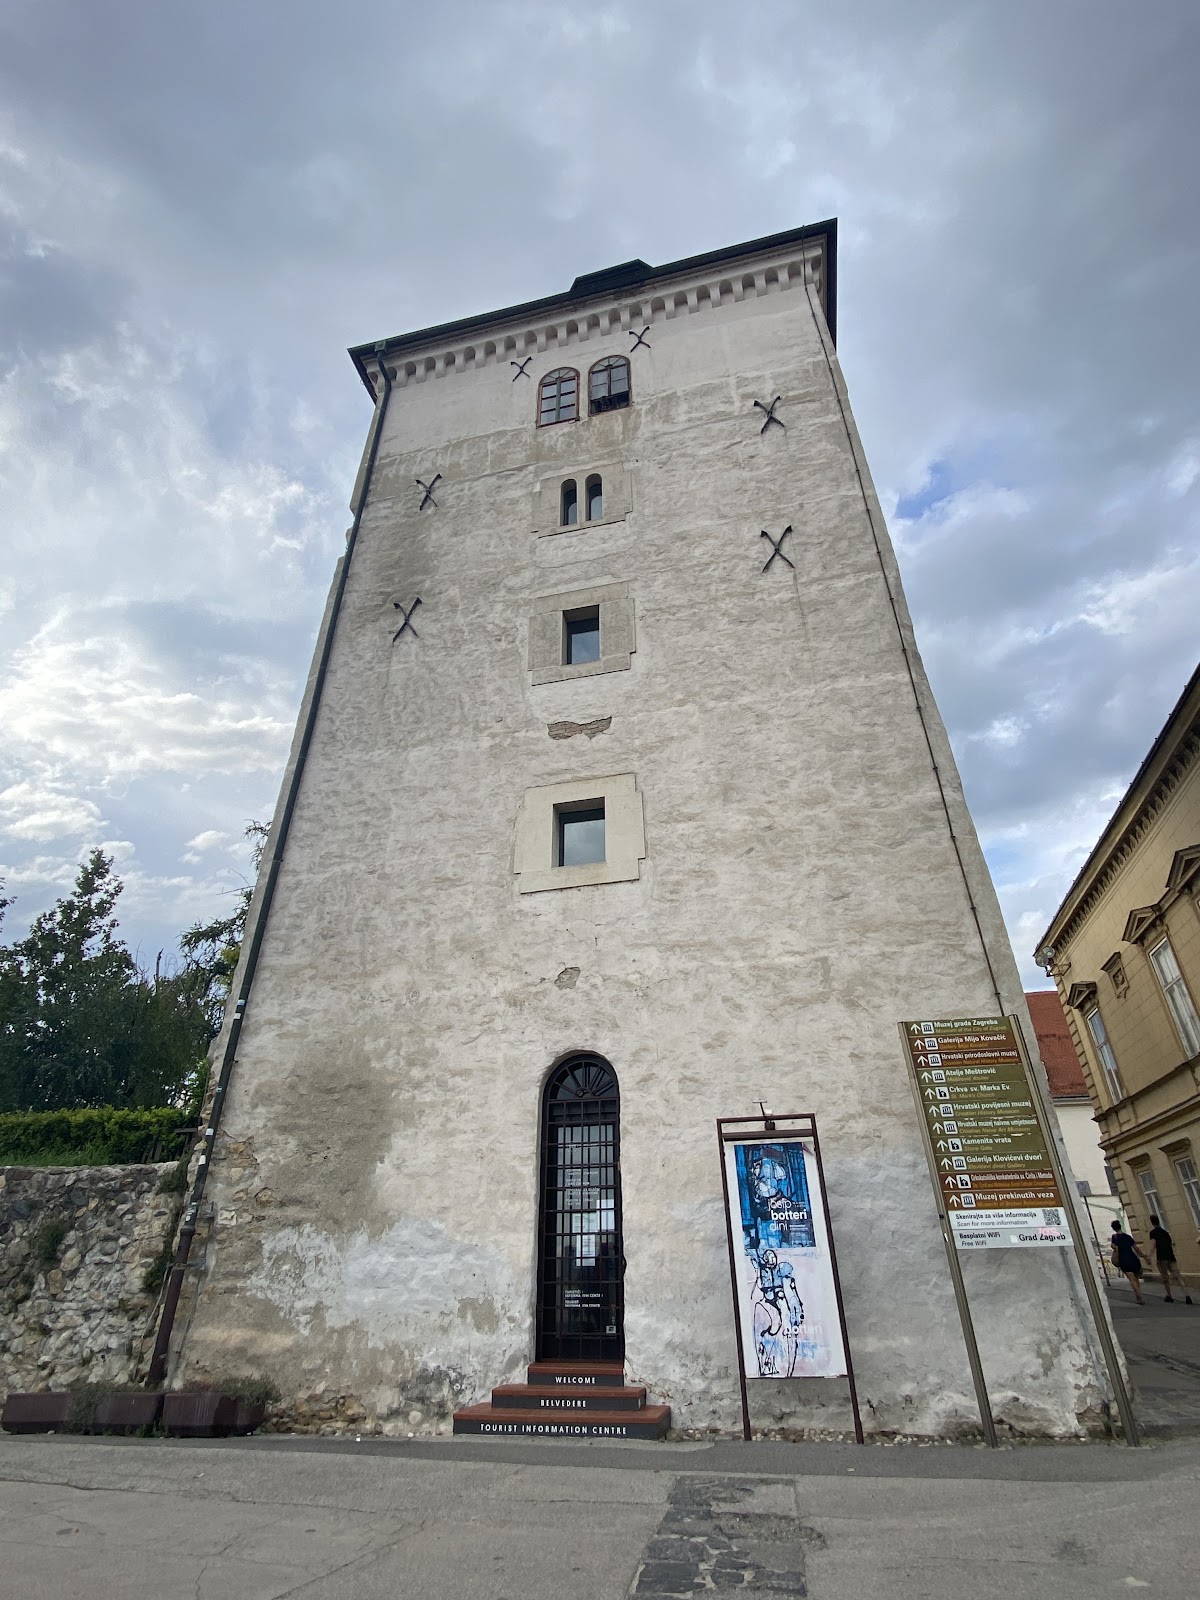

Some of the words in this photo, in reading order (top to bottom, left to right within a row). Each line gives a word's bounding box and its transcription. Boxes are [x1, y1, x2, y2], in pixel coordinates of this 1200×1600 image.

[999, 1192, 1036, 1200] prekinutih
[768, 1197, 791, 1211] josip
[771, 1209, 807, 1220] botteri
[770, 1220, 788, 1231] dini
[1040, 1233, 1066, 1242] Zagreb
[555, 1376, 596, 1384] WELCOME
[540, 1399, 587, 1408] BELVEDERE
[480, 1424, 517, 1432] TOURIST
[522, 1425, 590, 1434] INFORMATION
[592, 1426, 627, 1435] CENTRE
